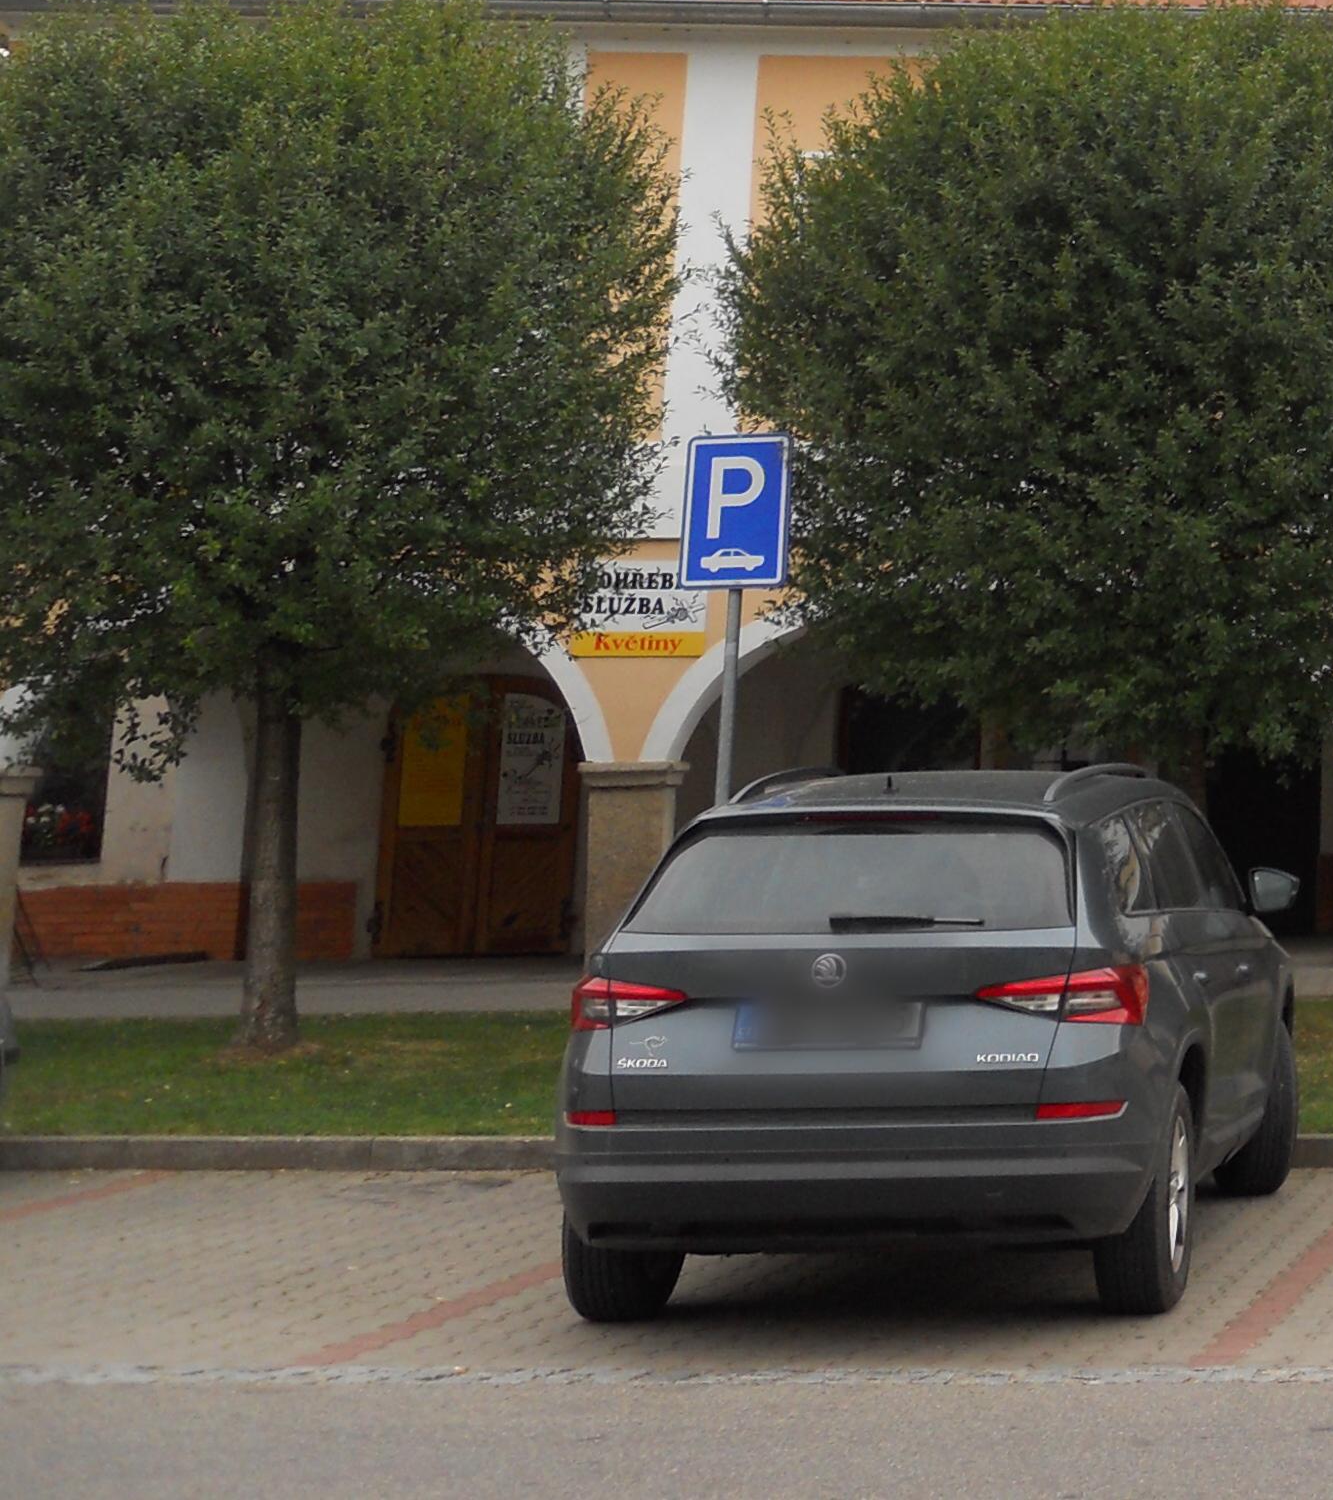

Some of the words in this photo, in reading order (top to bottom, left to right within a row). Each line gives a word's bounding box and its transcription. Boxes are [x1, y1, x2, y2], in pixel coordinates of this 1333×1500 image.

[706, 456, 765, 539] P
[590, 568, 682, 590] OHŘEB
[581, 593, 665, 615] SLUŽBA
[594, 633, 684, 654] Květiny
[616, 1057, 668, 1069] ŠKODA
[976, 1052, 1039, 1063] KODIAQ
